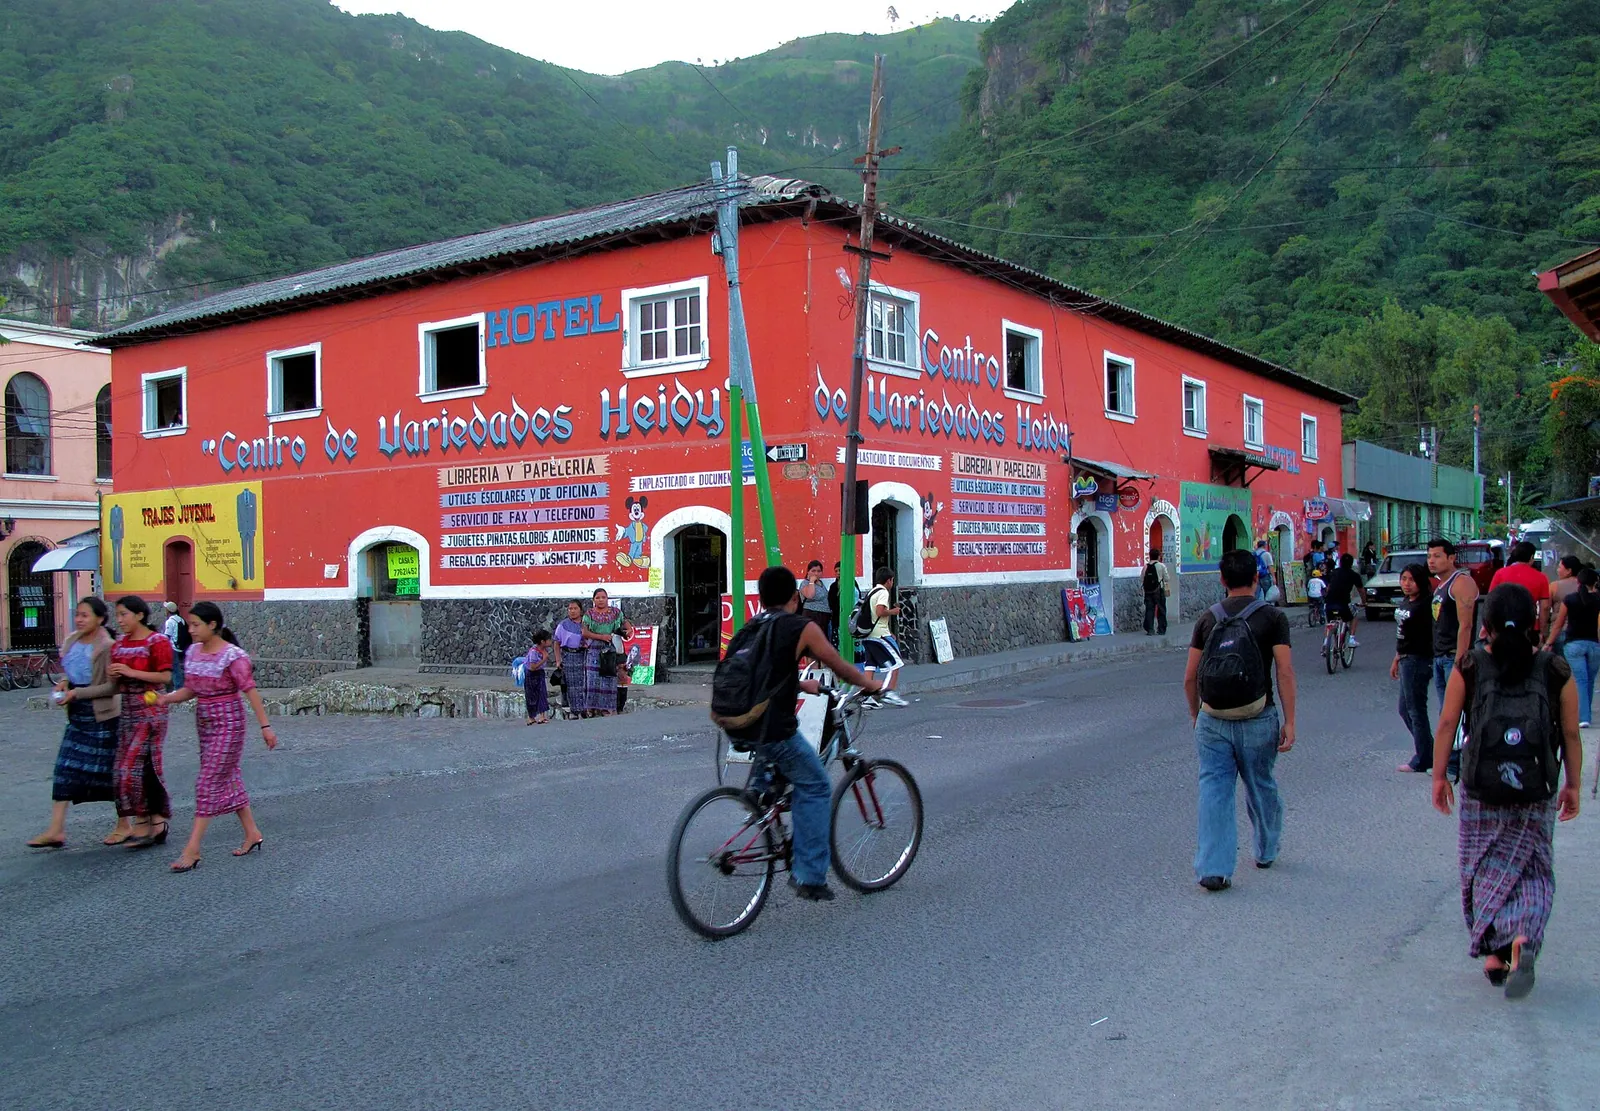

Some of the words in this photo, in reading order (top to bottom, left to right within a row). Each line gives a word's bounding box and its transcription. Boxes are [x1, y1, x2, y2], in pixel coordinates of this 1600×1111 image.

[486, 295, 620, 347] HOTEL
[922, 329, 1000, 388] Centro
[814, 363, 848, 422] de
[867, 375, 1006, 443] Variedades
[324, 415, 358, 462] de
[378, 393, 574, 457] Variedades
[889, 454, 896, 465] DE
[958, 455, 993, 475] LIBRERIA
[994, 460, 1001, 476] Y
[1003, 461, 1042, 480] PAPELERIA
[448, 465, 500, 486] LIBRERIA
[506, 465, 514, 481] Y
[523, 457, 596, 479] PAPELERIA
[448, 493, 477, 506] UTILES
[481, 489, 526, 504] ESCOLARES
[530, 488, 537, 500] Y
[540, 487, 551, 500] DE
[556, 484, 598, 499] OFICINA
[956, 480, 974, 492] UTILES
[975, 481, 1003, 495] ESCOLARES
[1005, 484, 1009, 495] Y
[1011, 484, 1018, 495] DE
[1019, 485, 1041, 496] OFICINA
[958, 501, 985, 513] SERVICIO
[988, 502, 995, 513] DE
[997, 503, 1008, 514] FAX
[1011, 504, 1015, 514] Y
[1018, 504, 1043, 515] TELEFONO
[1099, 495, 1115, 505] tigo
[142, 505, 175, 528] TRAJES
[177, 503, 216, 525] JUVENIL
[451, 513, 489, 527] SERVICIO
[492, 511, 503, 525] DE
[509, 511, 528, 524] FAX
[534, 510, 541, 521] Y
[545, 507, 595, 521] TELEFONO
[552, 529, 596, 543] ADORNOS
[1020, 523, 1040, 534] ADORNOS
